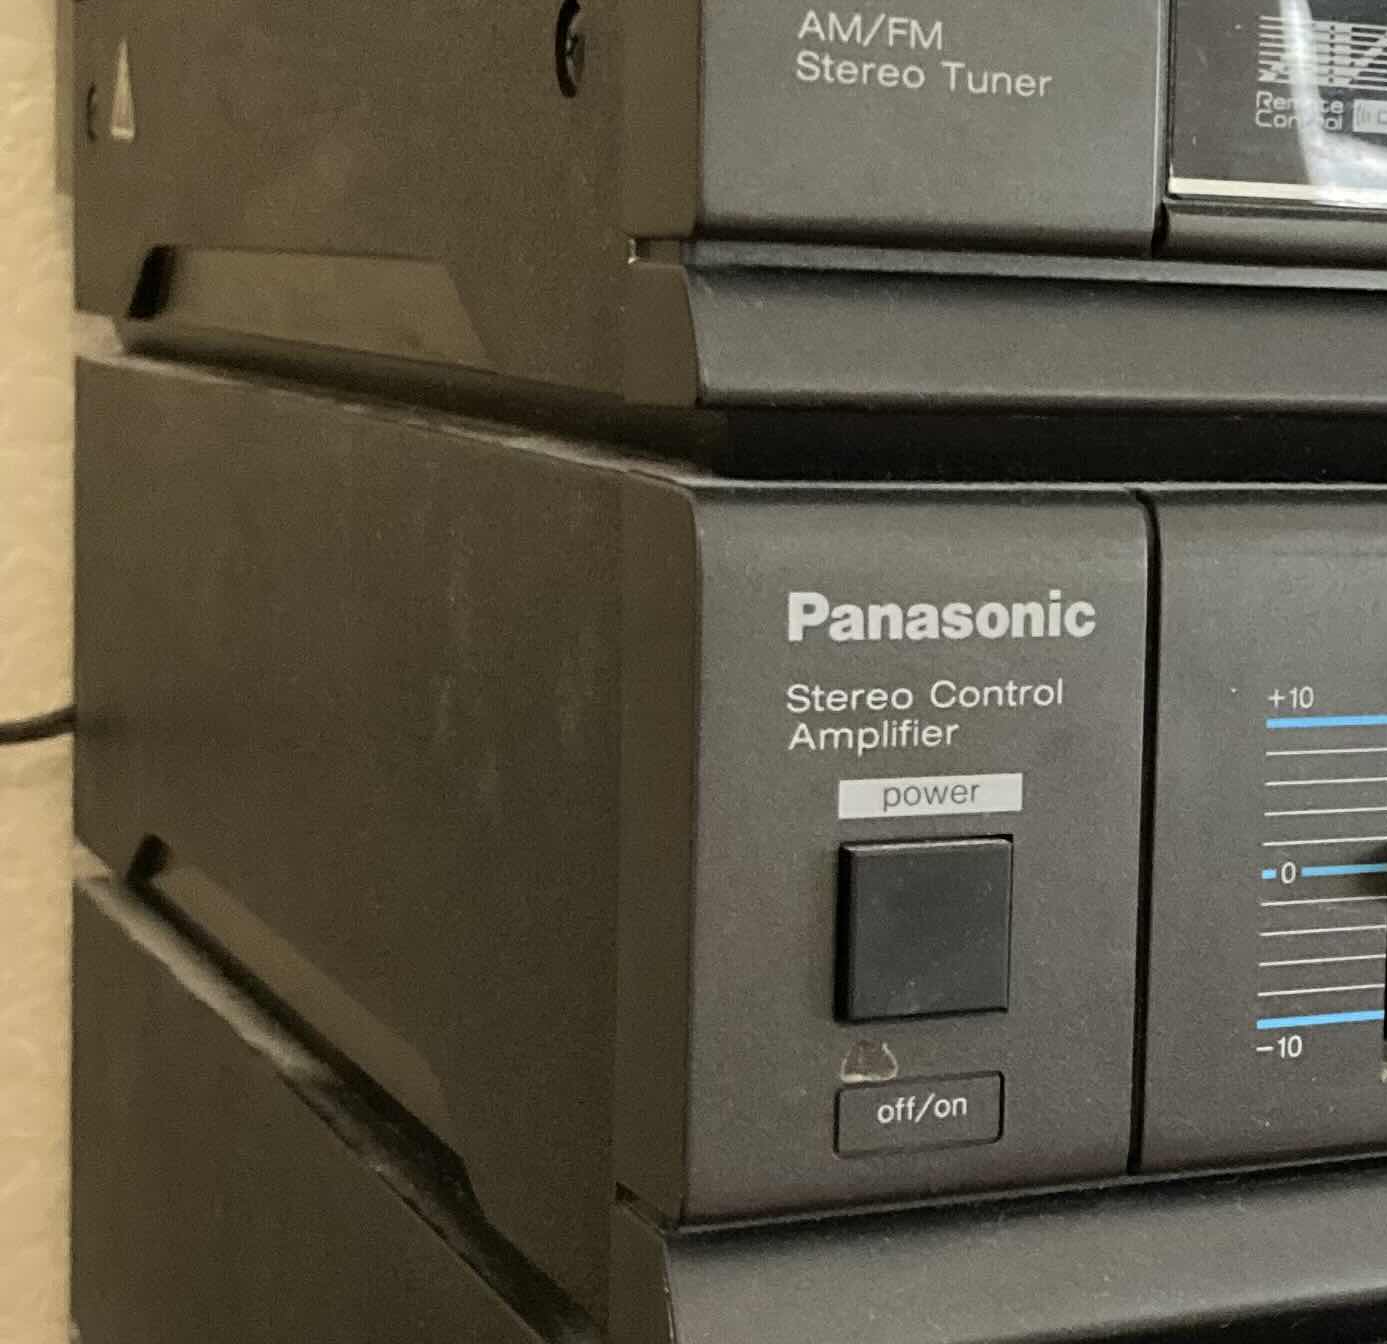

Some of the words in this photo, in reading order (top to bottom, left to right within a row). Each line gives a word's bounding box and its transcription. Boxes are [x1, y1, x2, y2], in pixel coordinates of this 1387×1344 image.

[798, 10, 943, 51] AM/FM
[796, 51, 926, 90] Stereo
[946, 61, 1053, 98] Tuner
[787, 589, 1097, 642] Panasonic
[786, 684, 913, 713] Stereo
[930, 678, 1063, 709] Control
[1267, 686, 1315, 710] +10
[788, 720, 959, 755] Amplifier
[882, 782, 980, 812] power
[1281, 862, 1297, 885] 0
[1256, 1035, 1302, 1058] -10
[877, 1092, 968, 1124] off/on
